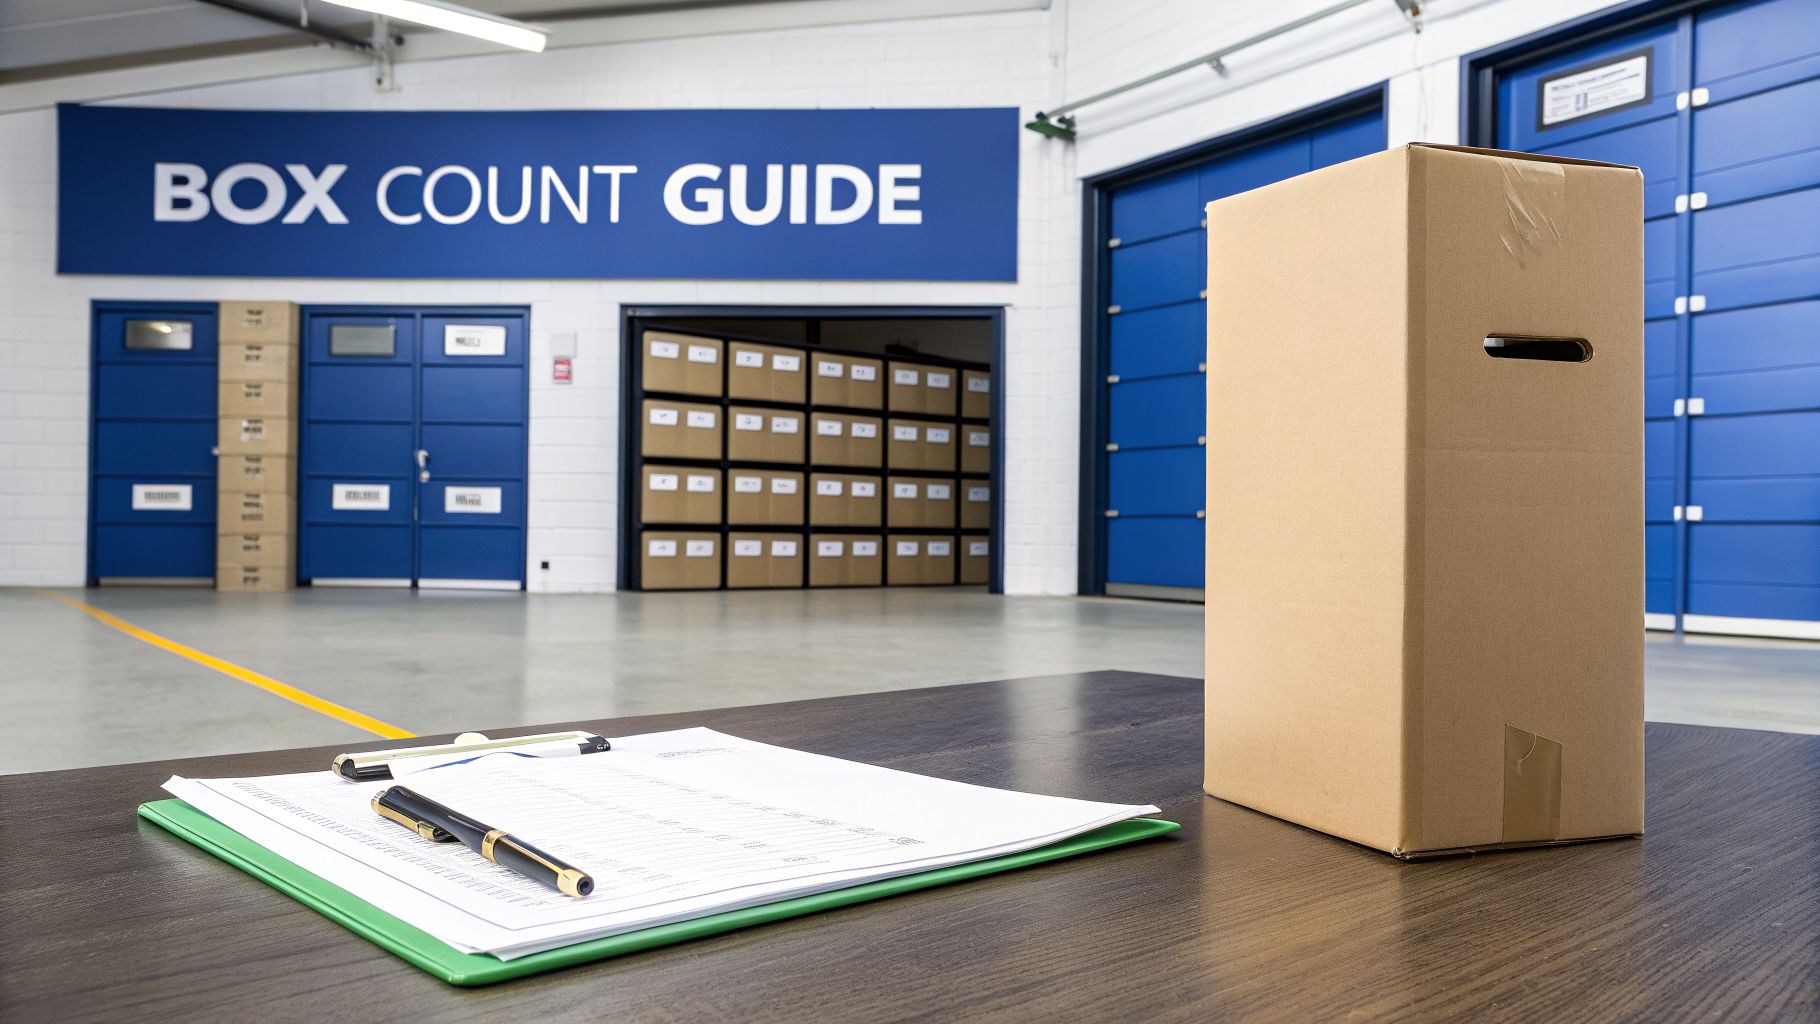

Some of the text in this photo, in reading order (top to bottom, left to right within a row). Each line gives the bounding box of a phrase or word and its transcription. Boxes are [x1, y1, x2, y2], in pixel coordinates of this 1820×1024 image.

[154, 163, 923, 226] BOX COUNT GUIDE
